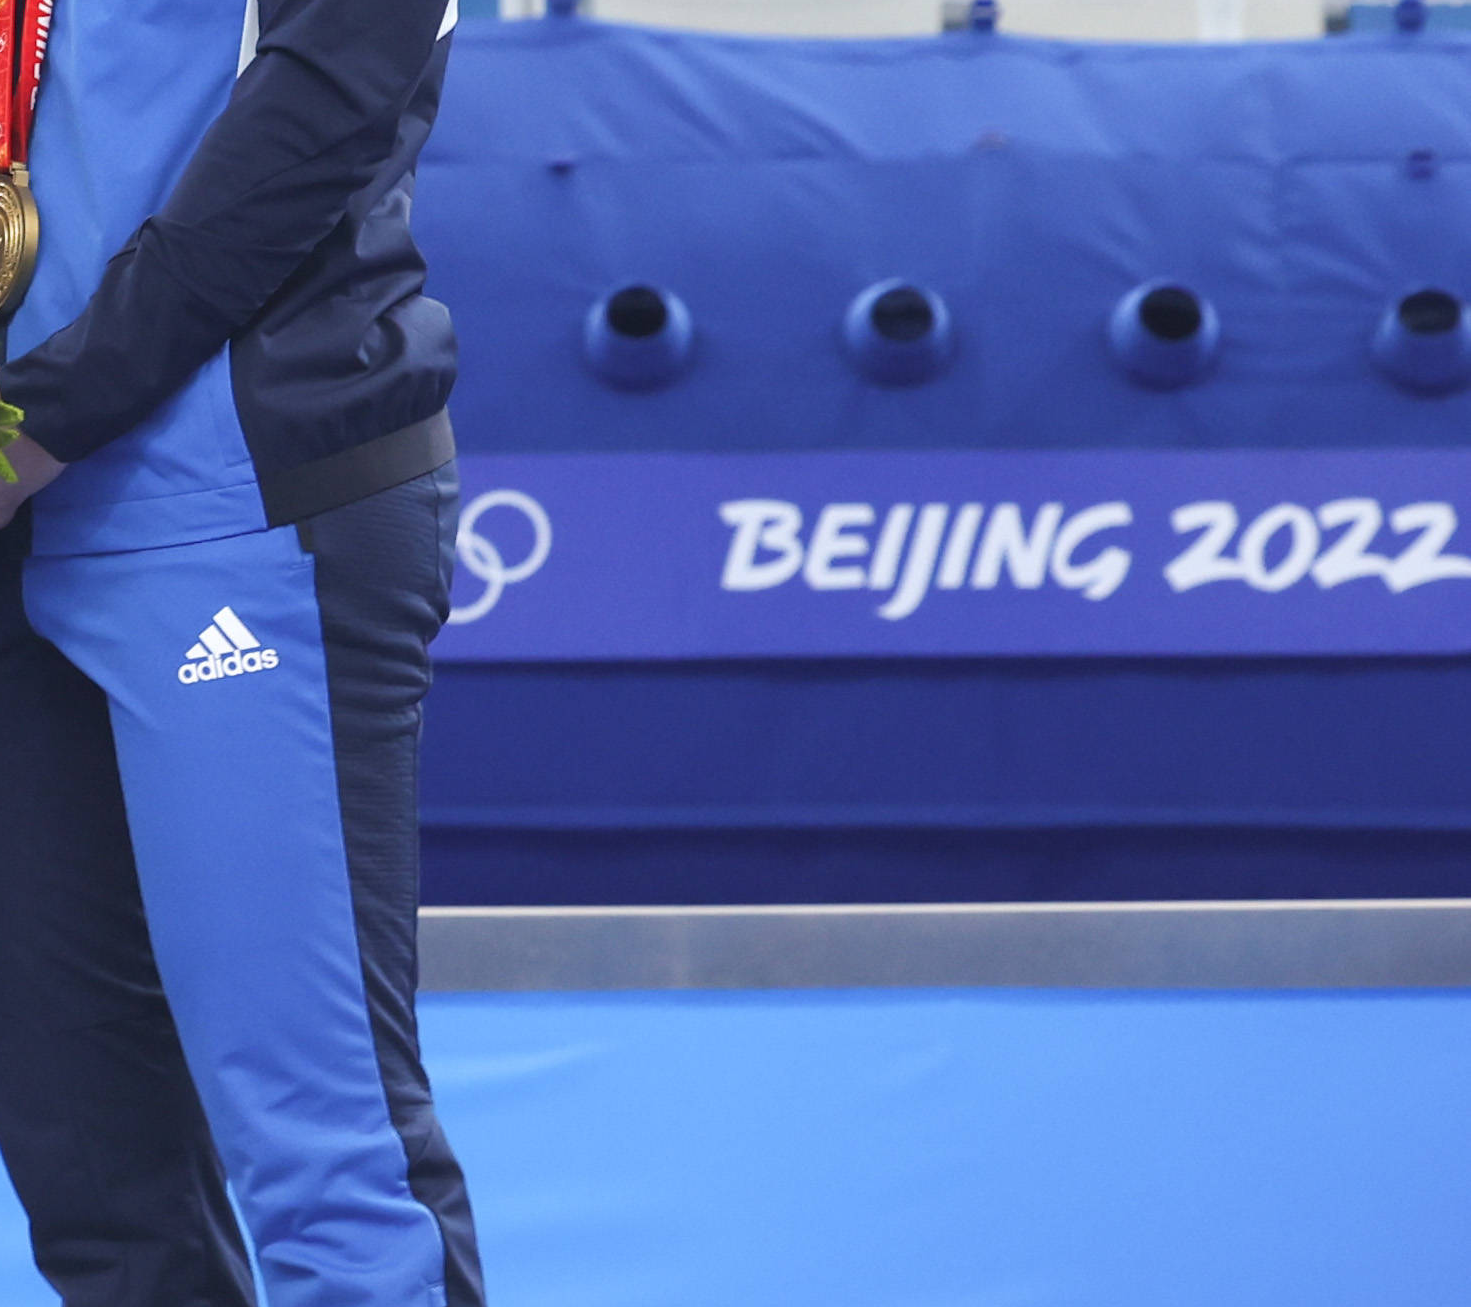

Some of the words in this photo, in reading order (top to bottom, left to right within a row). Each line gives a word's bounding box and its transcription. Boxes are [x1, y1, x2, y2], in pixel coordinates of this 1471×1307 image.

[719, 500, 1131, 620] BEIJING
[1164, 498, 1471, 593] 2022
[177, 641, 279, 685] adidas
